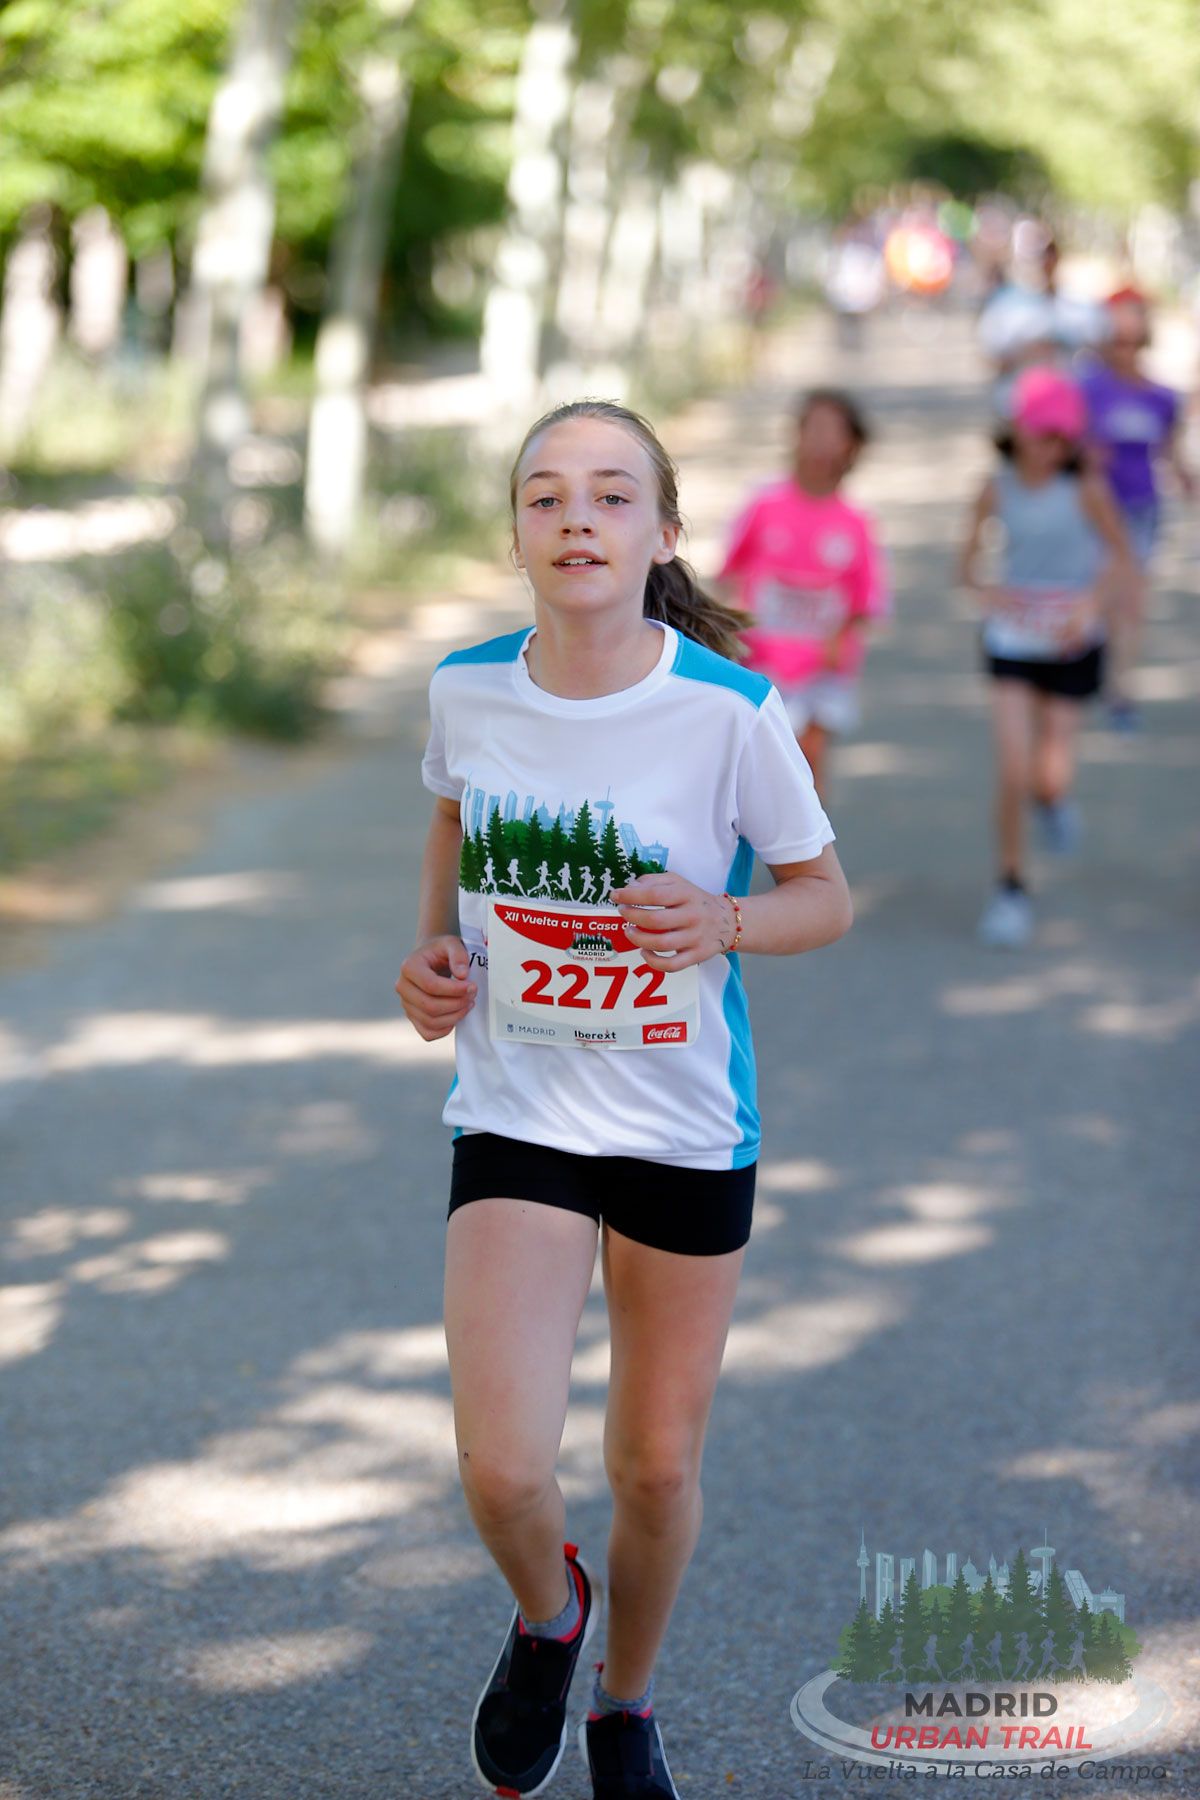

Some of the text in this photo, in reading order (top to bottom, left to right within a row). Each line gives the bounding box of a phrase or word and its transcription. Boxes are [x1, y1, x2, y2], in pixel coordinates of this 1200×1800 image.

[504, 911, 519, 922] XII
[521, 914, 558, 927] Vuelta
[561, 920, 568, 929] a
[572, 920, 583, 930] la
[588, 921, 618, 931] Casa
[521, 960, 668, 1009] 2272
[518, 1026, 555, 1036] MADRID
[574, 1030, 616, 1040] Iberext
